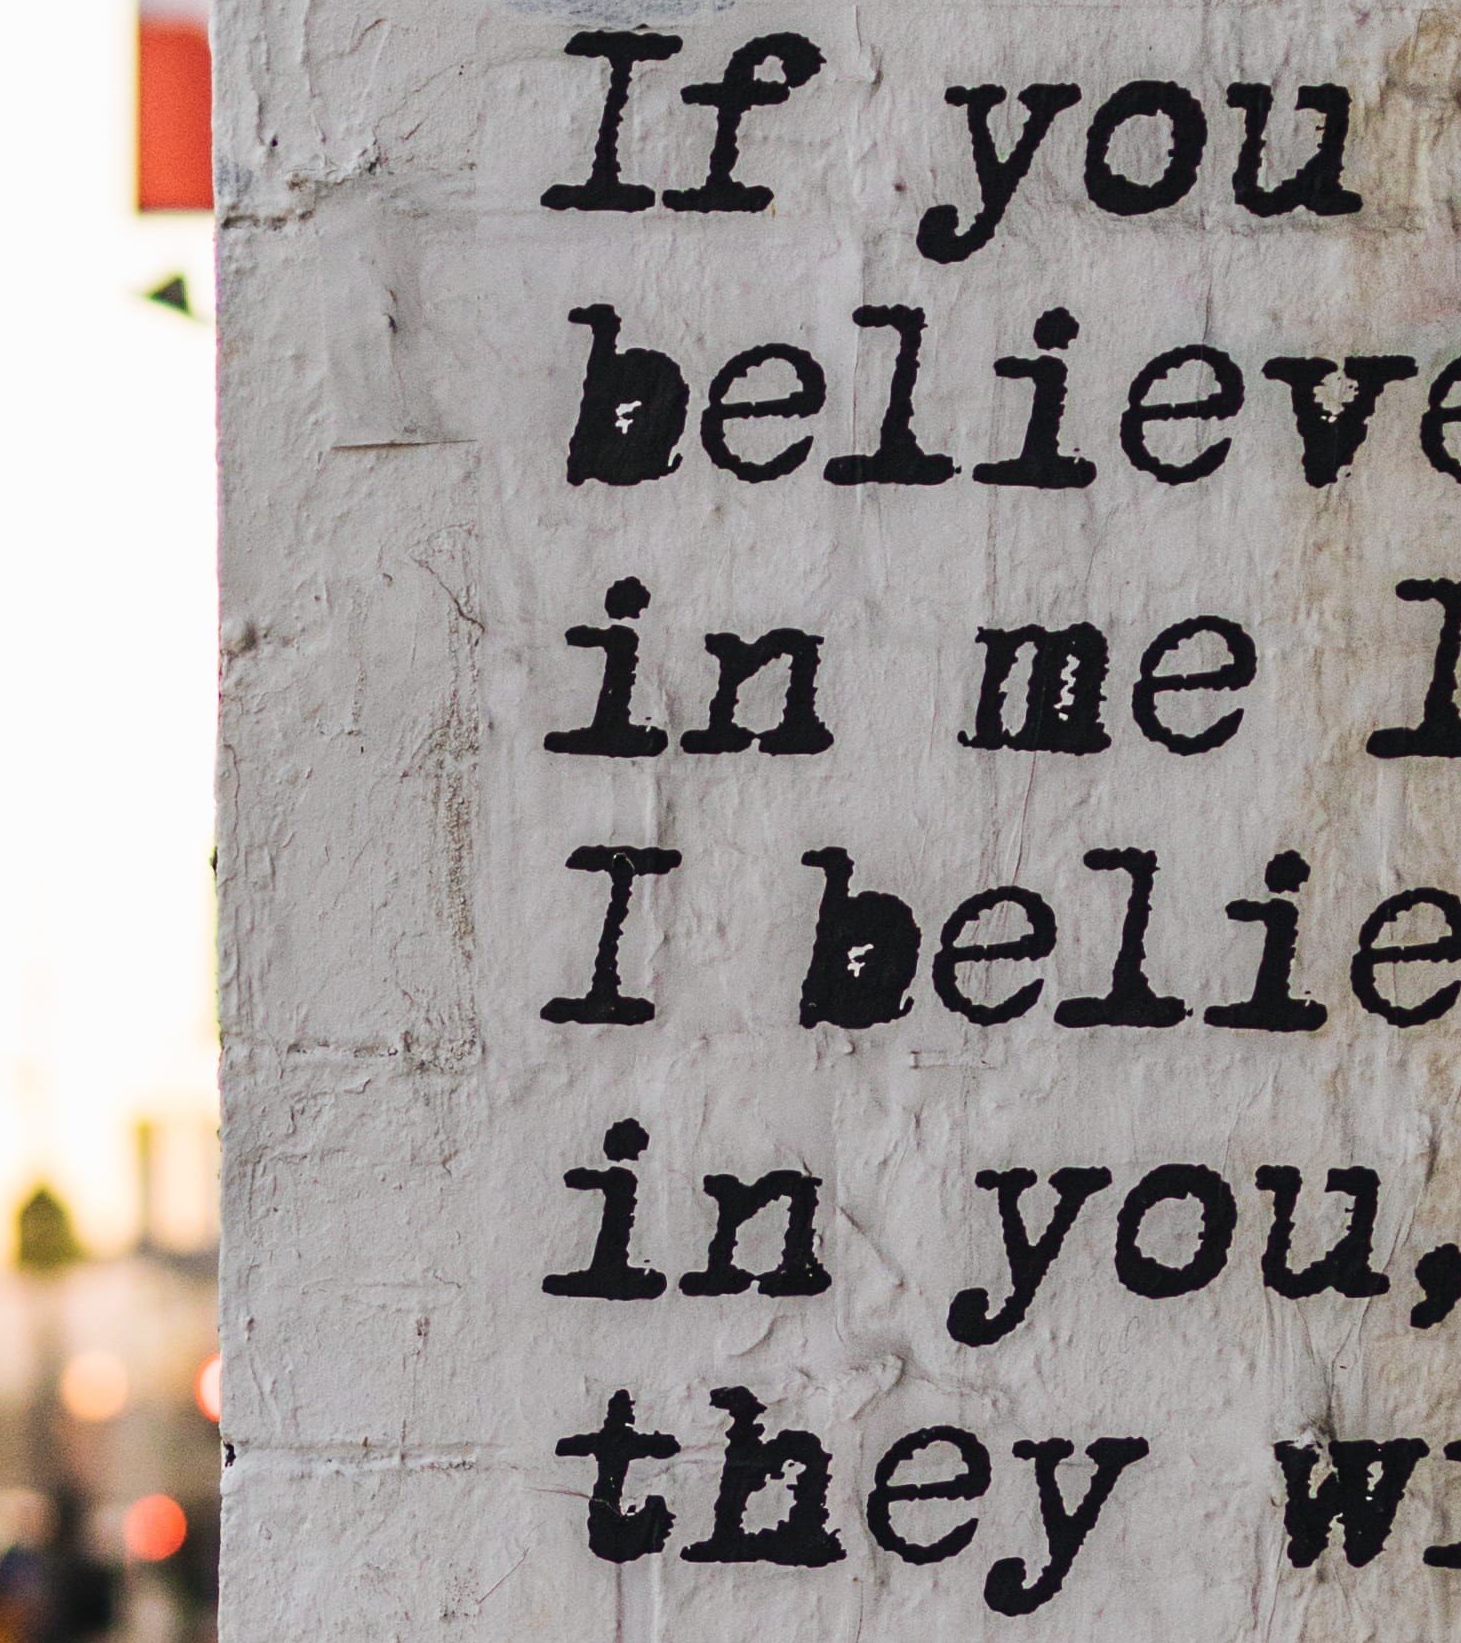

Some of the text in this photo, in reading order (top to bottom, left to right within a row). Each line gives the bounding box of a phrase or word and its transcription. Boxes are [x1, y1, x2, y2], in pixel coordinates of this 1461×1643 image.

[541, 30, 1363, 265] If you
[544, 576, 835, 759] in
[957, 616, 1257, 757] me
[540, 845, 683, 1027] I
[542, 1117, 833, 1302] in
[555, 1385, 1150, 1618] they
